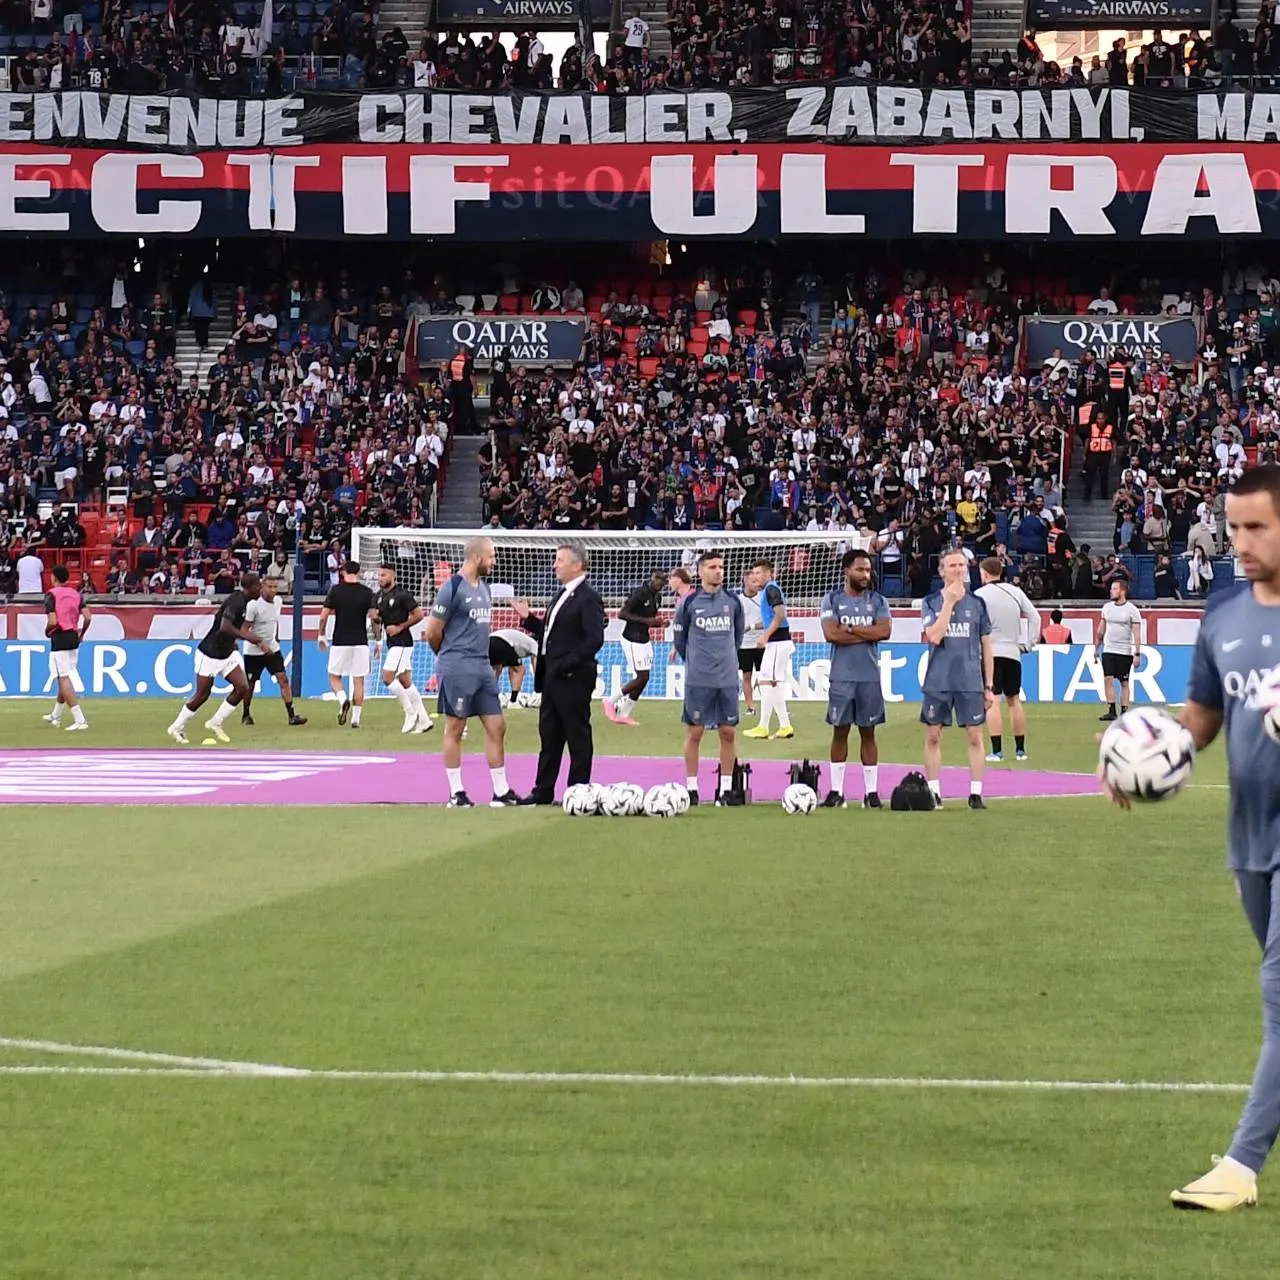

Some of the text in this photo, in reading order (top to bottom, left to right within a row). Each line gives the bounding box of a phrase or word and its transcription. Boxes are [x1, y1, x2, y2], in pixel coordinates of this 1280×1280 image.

[503, 1, 573, 15] AIRWAYS
[1098, 1, 1169, 15] AIRWAYS
[357, 92, 748, 144] CHEVALIER,
[452, 320, 549, 348] QATAR
[1063, 321, 1162, 348] QATAR
[695, 616, 731, 629] QATAR
[840, 615, 873, 626] QATAR
[946, 622, 970, 632] ATAR
